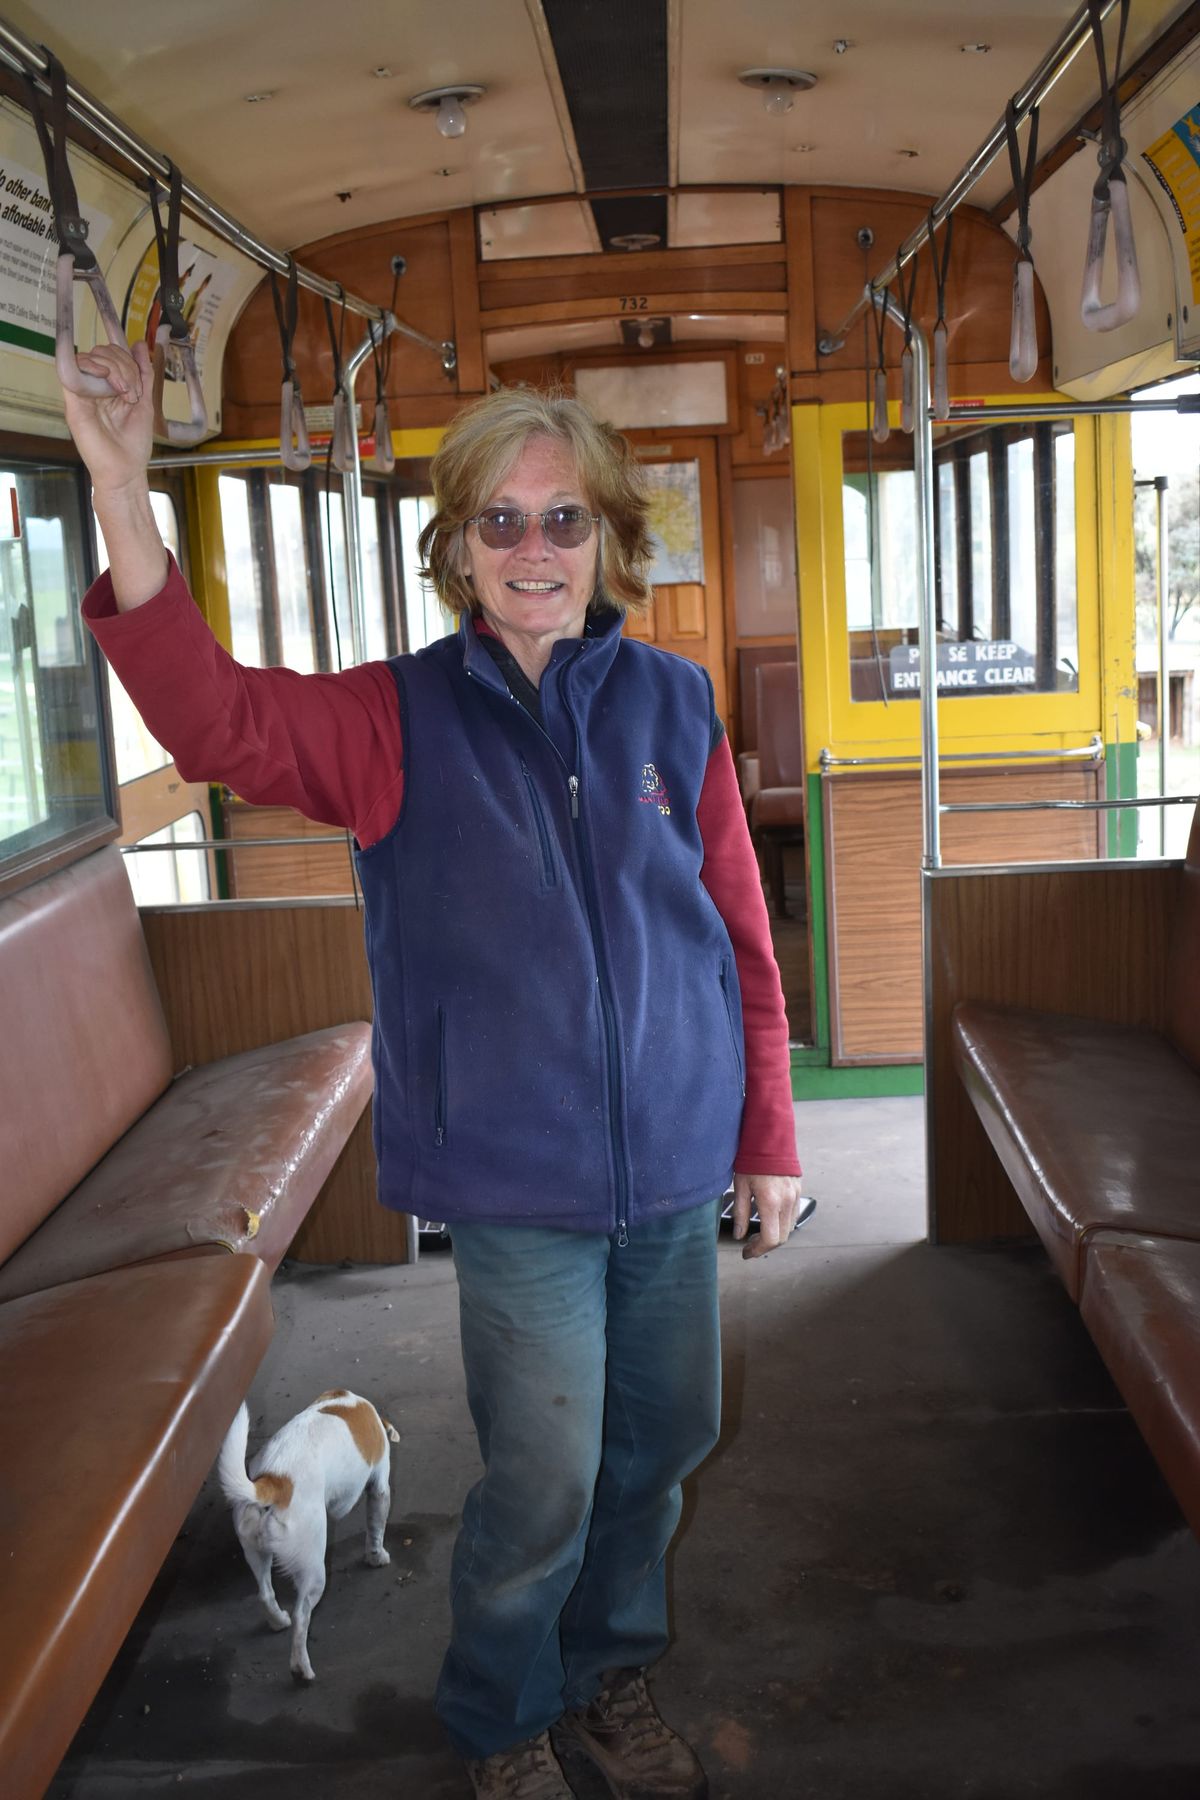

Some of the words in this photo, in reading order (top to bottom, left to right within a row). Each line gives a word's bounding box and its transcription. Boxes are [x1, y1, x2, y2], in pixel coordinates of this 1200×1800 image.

[5, 179, 32, 201] other
[30, 188, 52, 213] bank
[2, 204, 46, 236] affordable
[619, 296, 648, 310] 732
[909, 646, 968, 664] PSE
[975, 644, 1018, 661] KEEP
[894, 669, 977, 688] ENTANCE
[984, 667, 1037, 684] CLEAR
